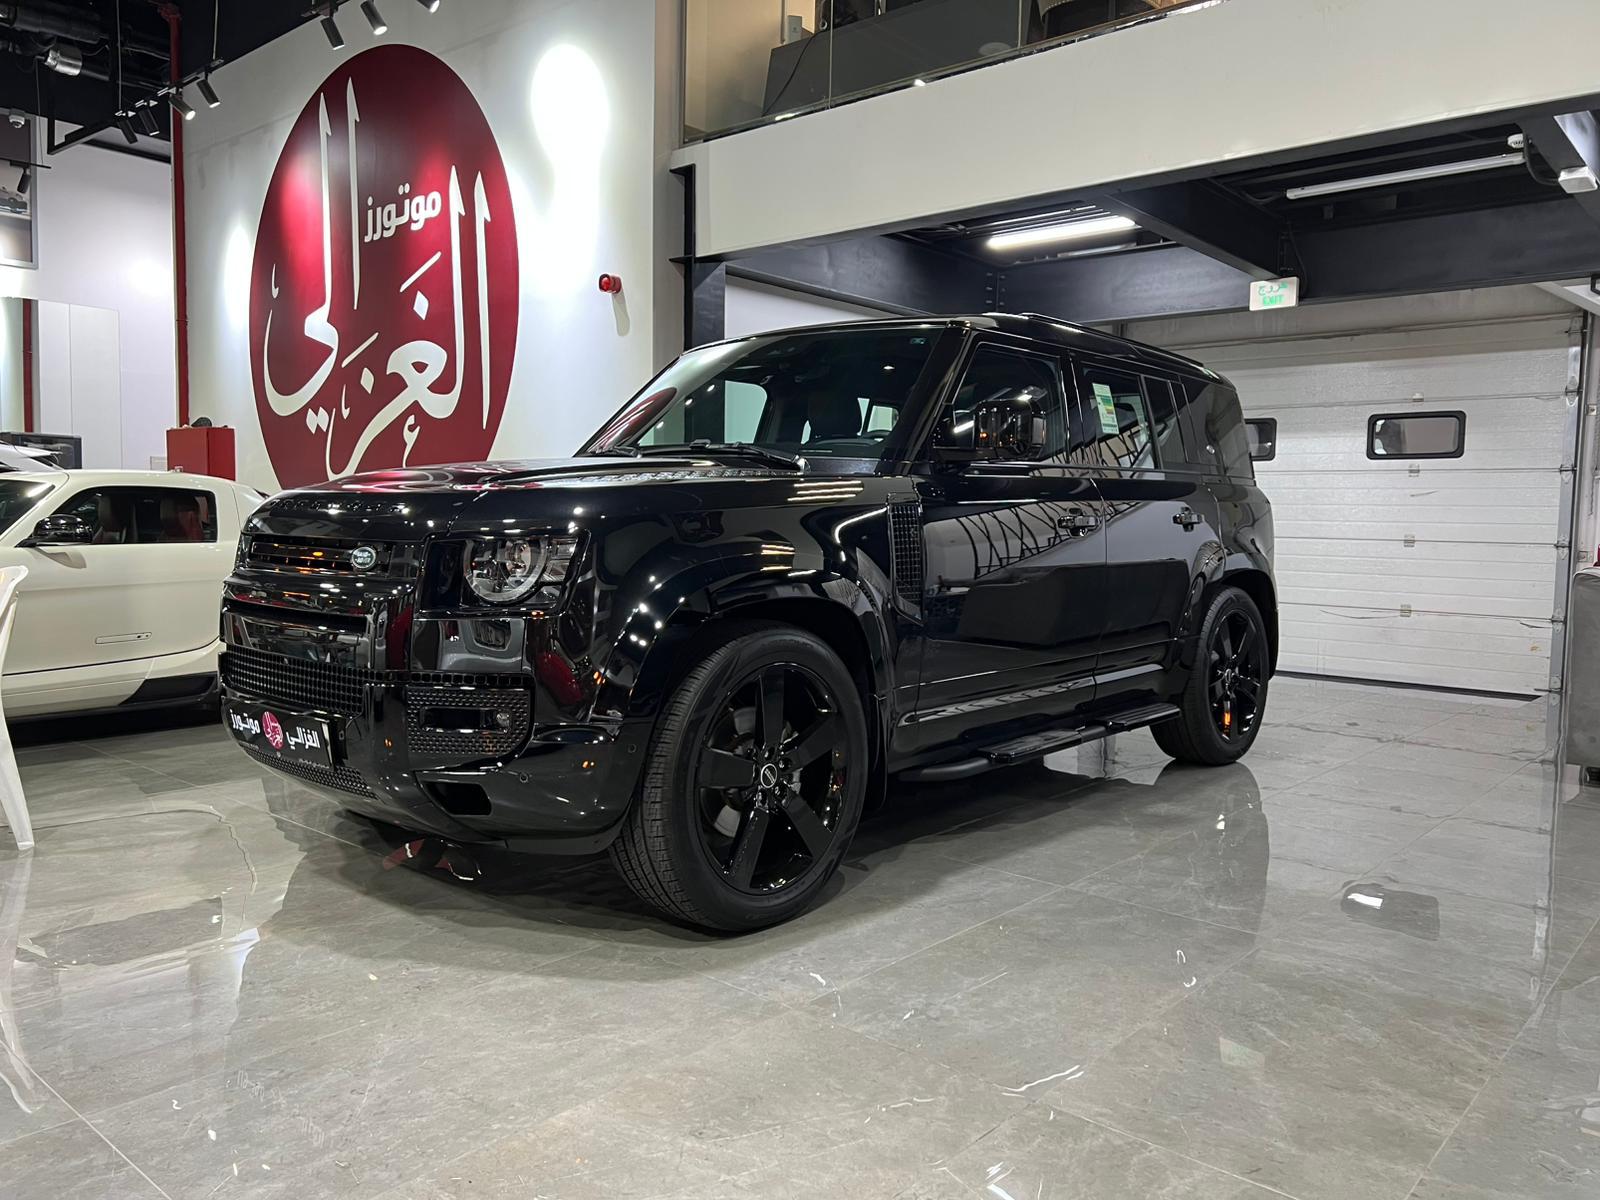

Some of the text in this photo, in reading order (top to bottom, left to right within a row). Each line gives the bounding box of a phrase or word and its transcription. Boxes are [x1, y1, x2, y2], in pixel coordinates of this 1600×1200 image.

[364, 184, 441, 243] موتورز
[230, 709, 320, 749] الغزالي موتورز
